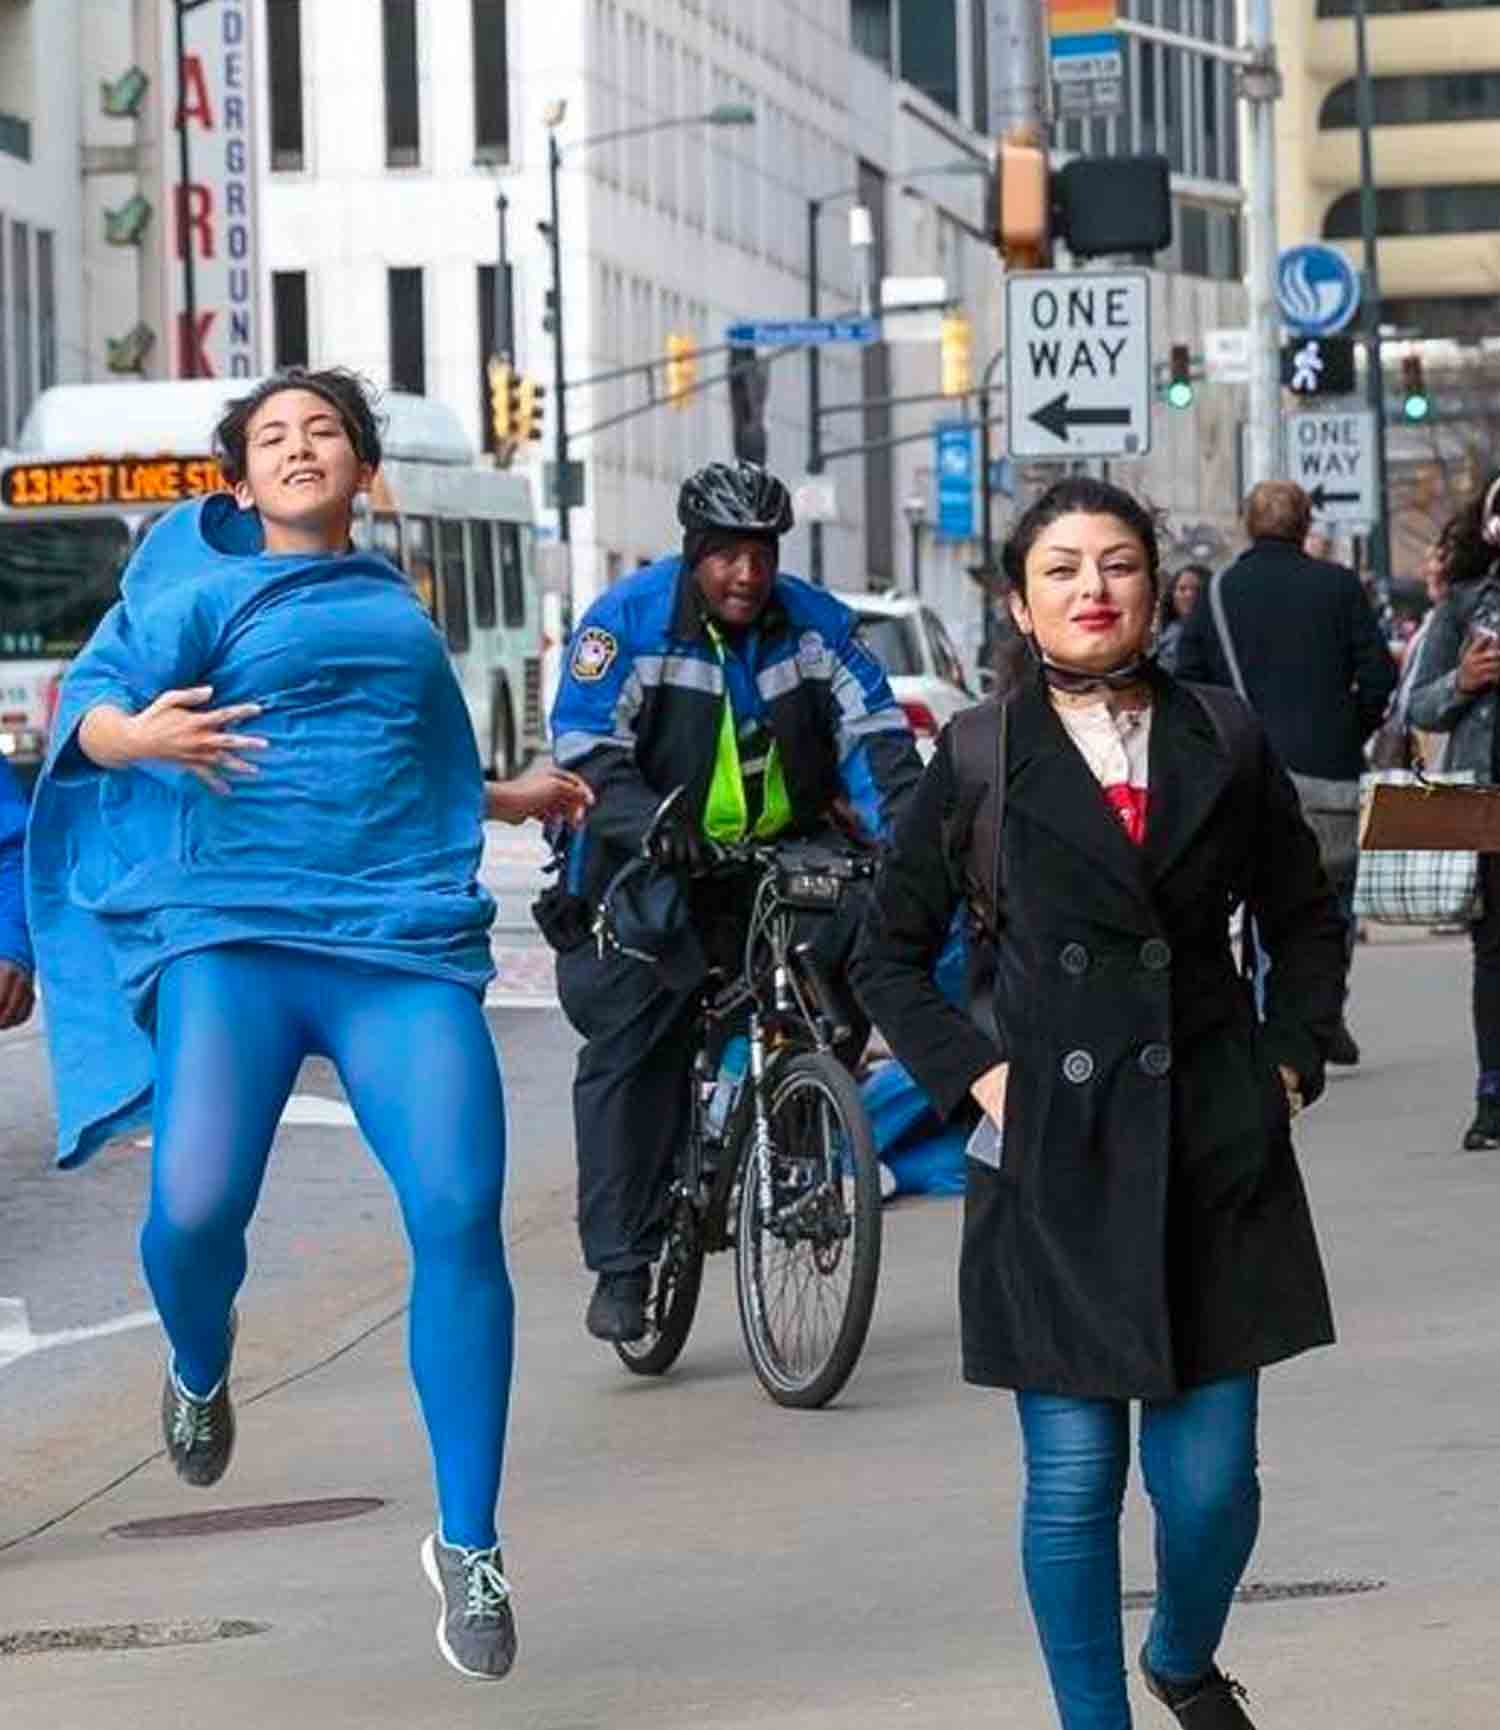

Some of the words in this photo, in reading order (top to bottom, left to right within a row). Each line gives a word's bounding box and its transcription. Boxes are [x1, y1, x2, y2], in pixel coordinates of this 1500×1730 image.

[1032, 288, 1129, 329] ONE
[1028, 338, 1127, 379] WAY
[1298, 420, 1360, 446] ONE
[1301, 450, 1361, 476] WAY
[12, 468, 48, 504] 13
[50, 464, 111, 502] WEST
